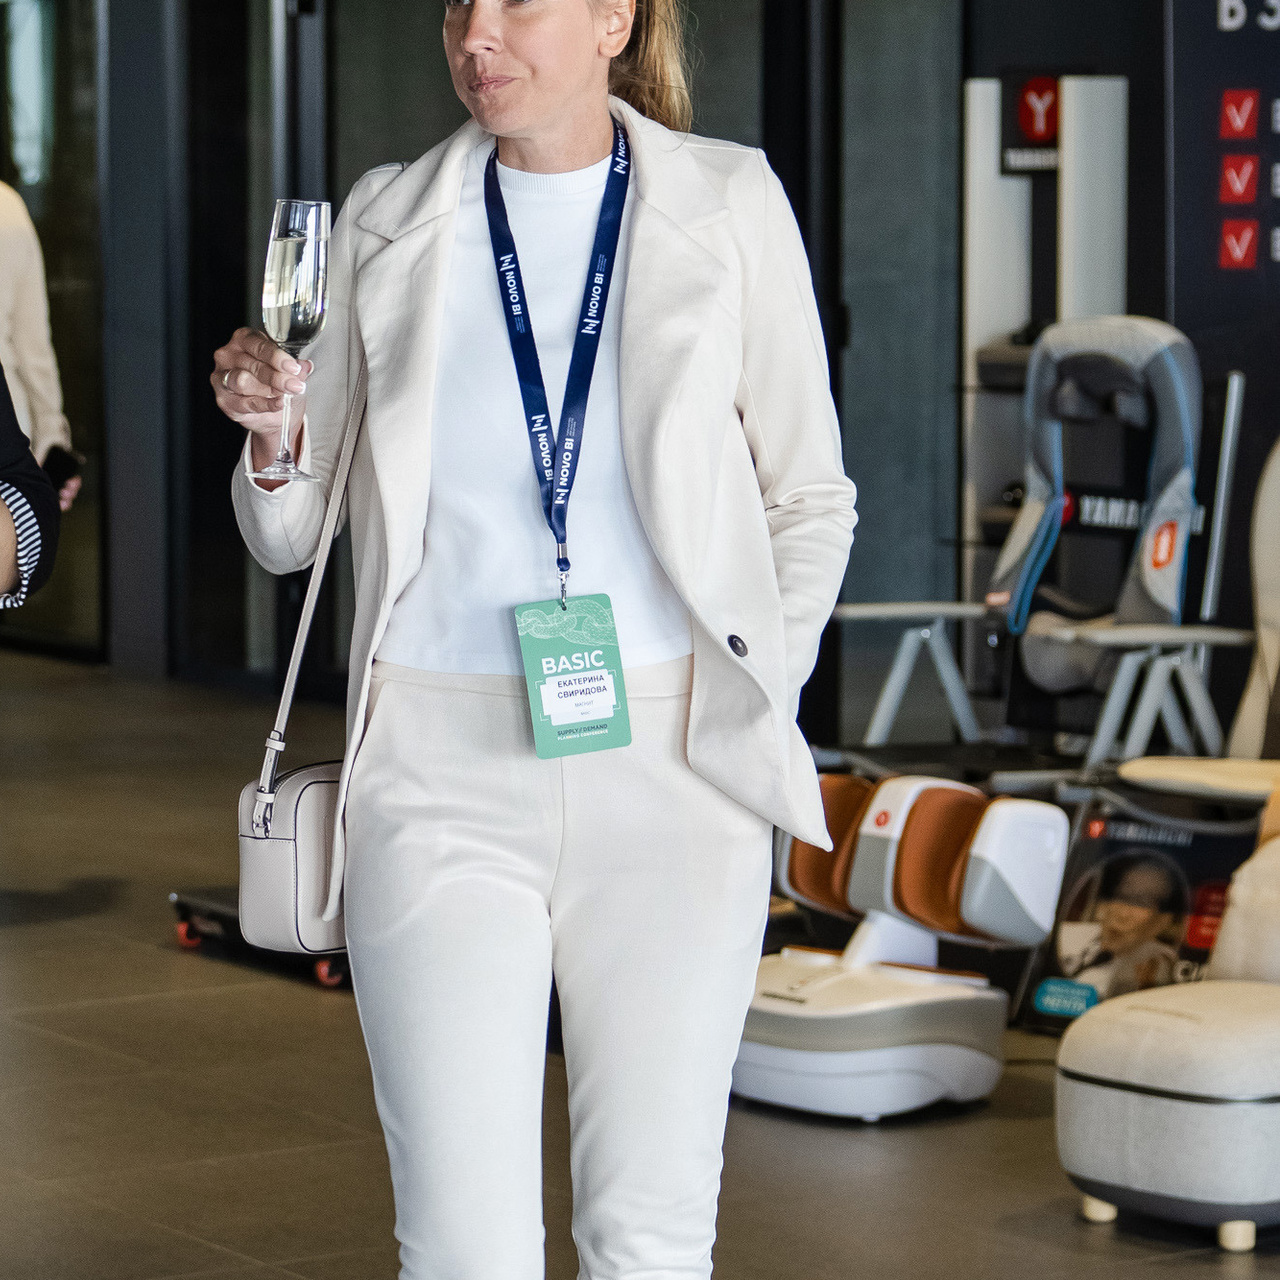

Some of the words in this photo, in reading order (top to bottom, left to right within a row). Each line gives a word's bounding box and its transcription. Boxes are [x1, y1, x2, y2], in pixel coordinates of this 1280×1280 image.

[594, 273, 604, 285] BI
[505, 271, 519, 303] NOVO
[512, 304, 522, 315] BI
[587, 285, 602, 317] NOVO
[538, 433, 552, 468] NOVO
[564, 438, 575, 450] BI
[544, 468, 554, 481] BI
[560, 452, 572, 486] NOVO
[541, 650, 605, 675] BASIC
[557, 675, 604, 688] ЕКАТЕРИНА
[557, 685, 607, 699] СВИРИДОВА
